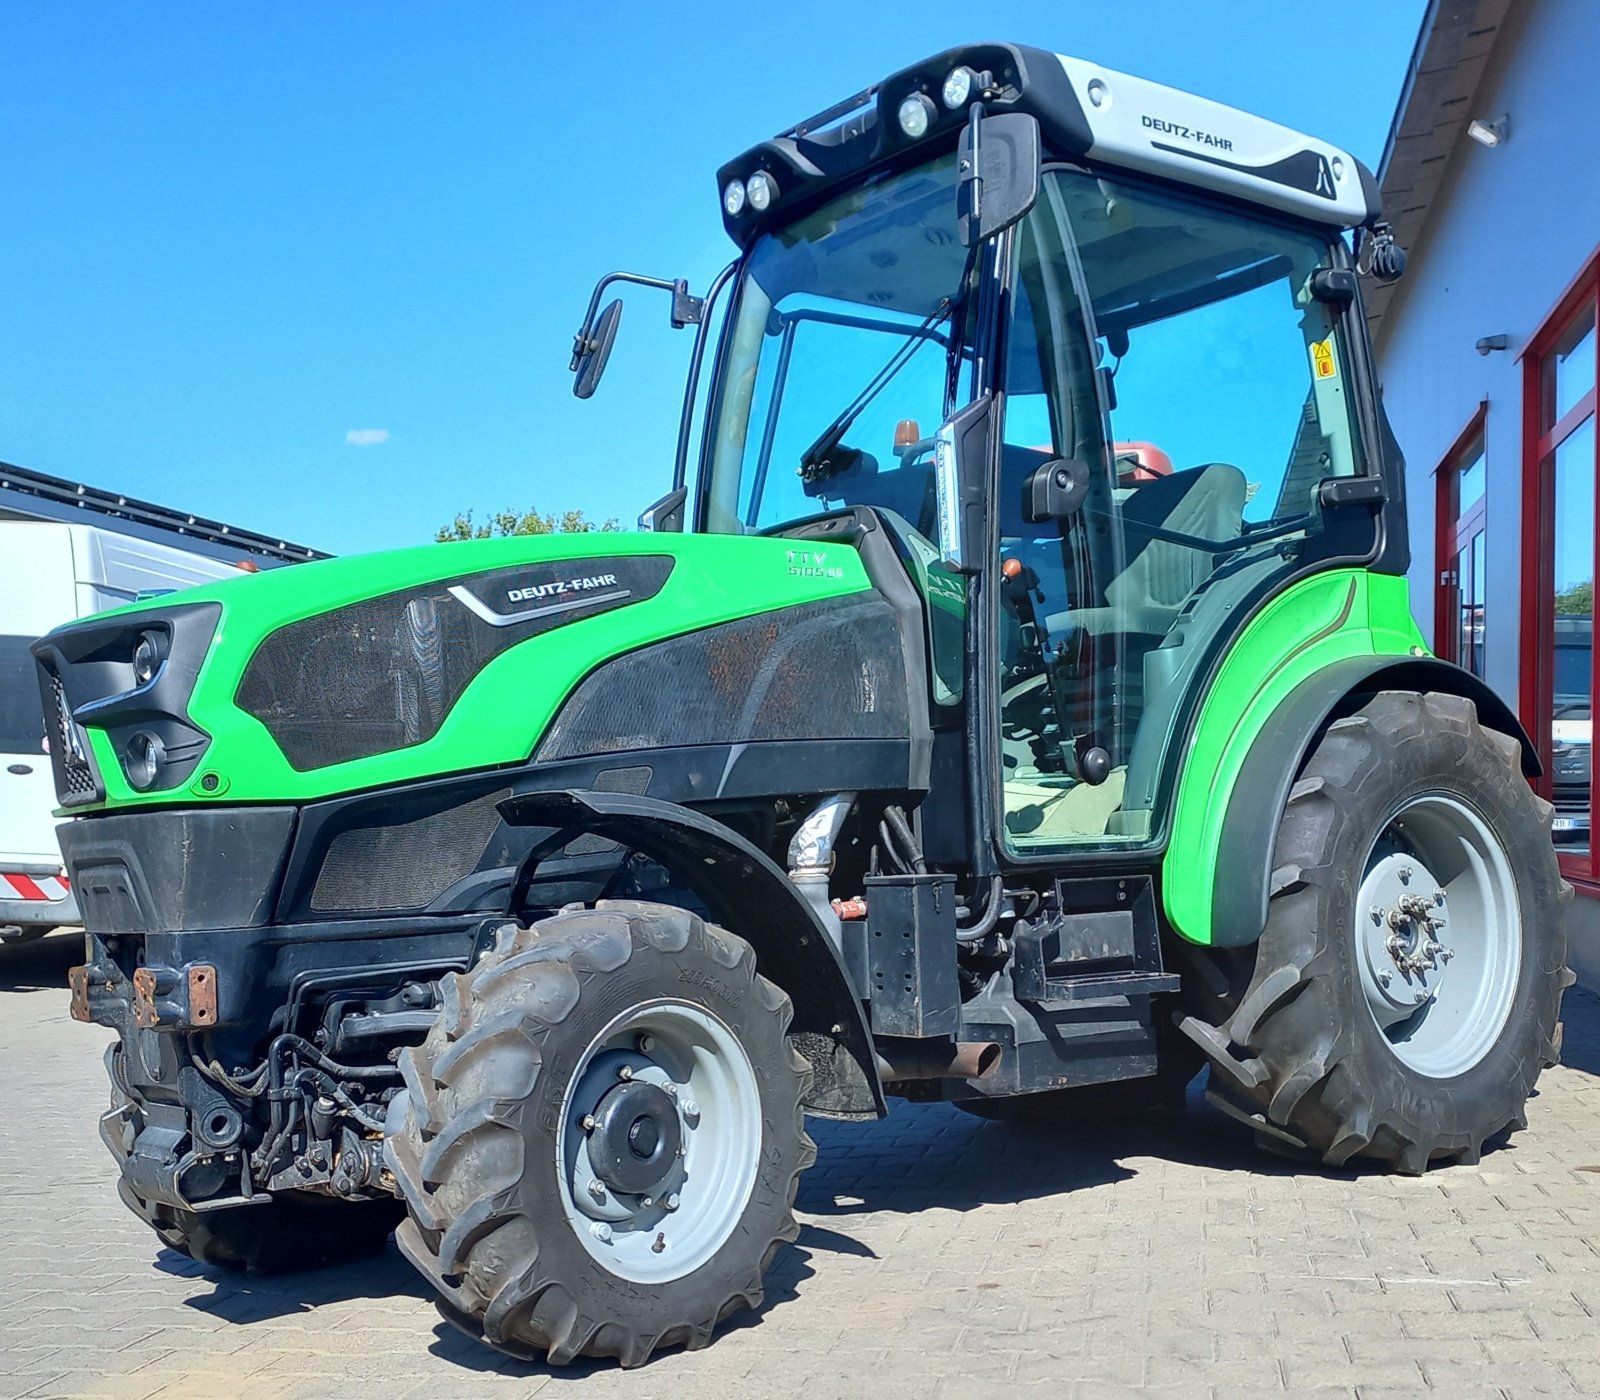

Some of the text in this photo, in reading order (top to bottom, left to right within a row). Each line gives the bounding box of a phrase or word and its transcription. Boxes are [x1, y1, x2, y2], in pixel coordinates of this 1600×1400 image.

[1141, 115, 1233, 152] DEUTZ-FAHR
[786, 550, 825, 564] TTV
[507, 574, 618, 603] DEUTZ-FAHR
